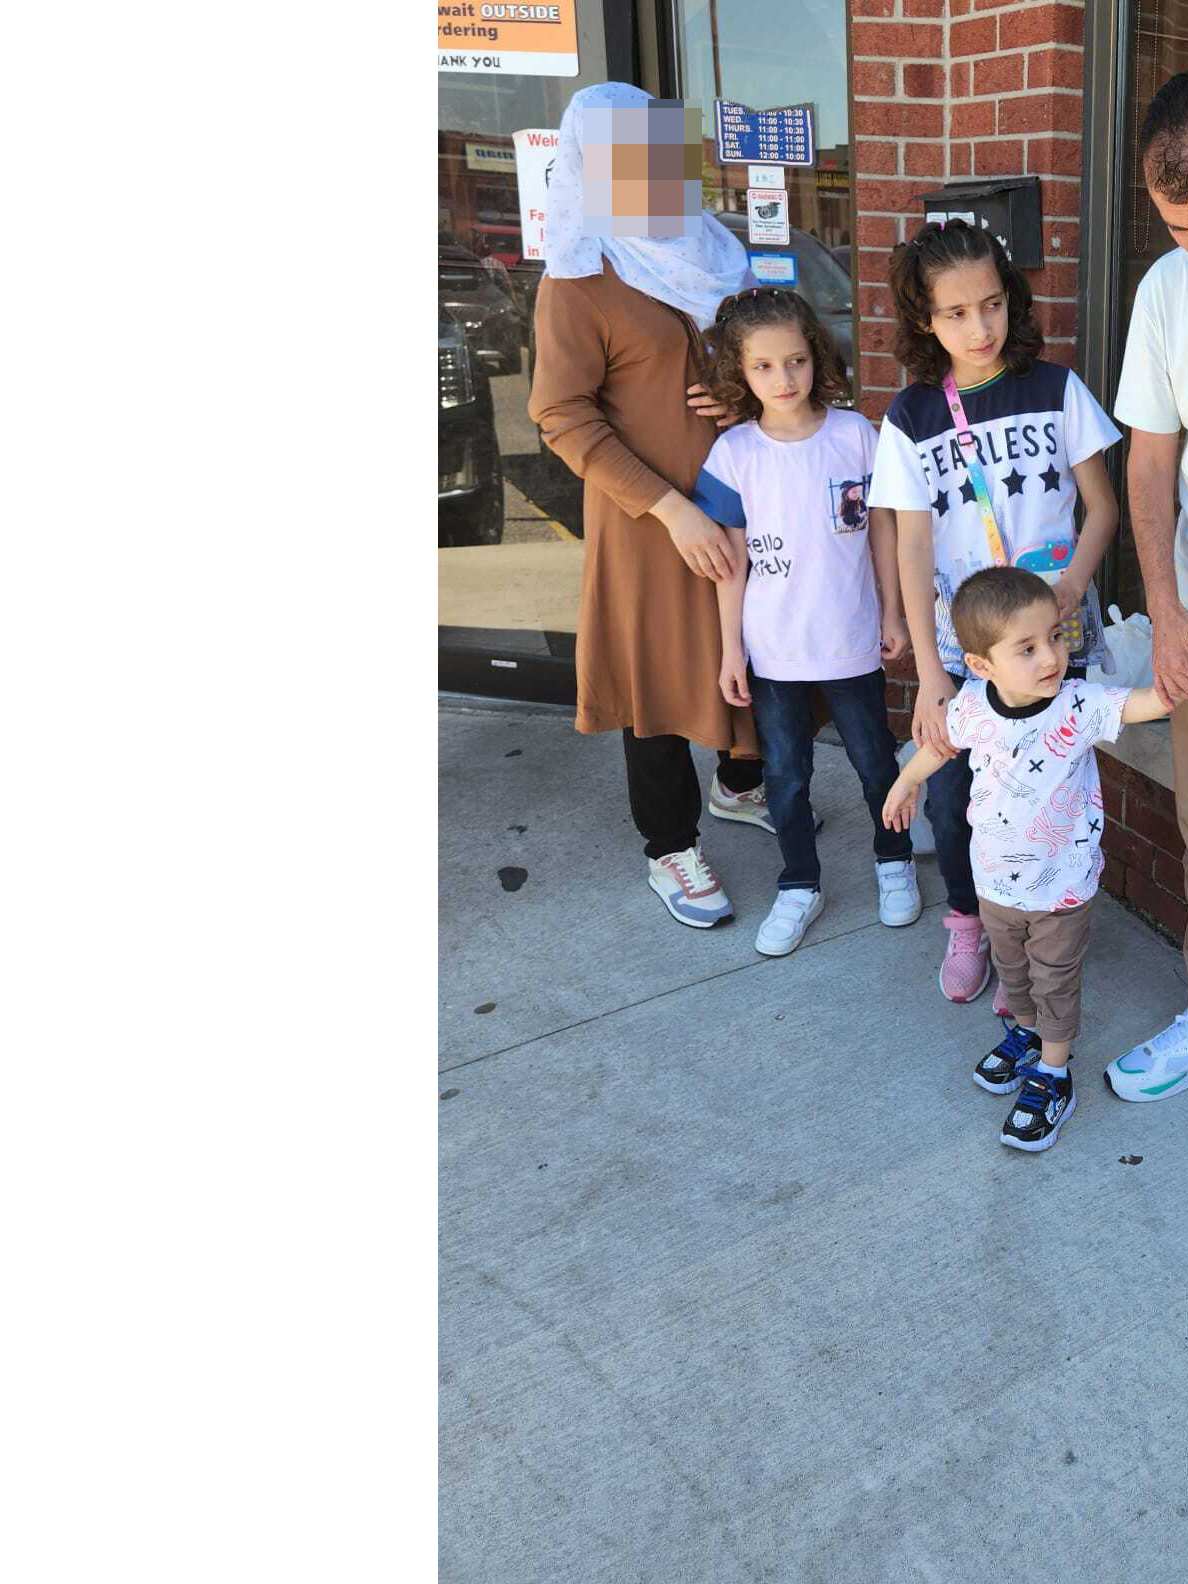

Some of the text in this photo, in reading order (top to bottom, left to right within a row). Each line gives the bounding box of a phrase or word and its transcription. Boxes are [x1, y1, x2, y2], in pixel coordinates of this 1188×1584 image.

[481, 4, 560, 20] OUTSIDE
[472, 56, 501, 68] YOU
[724, 115, 743, 124] WED.
